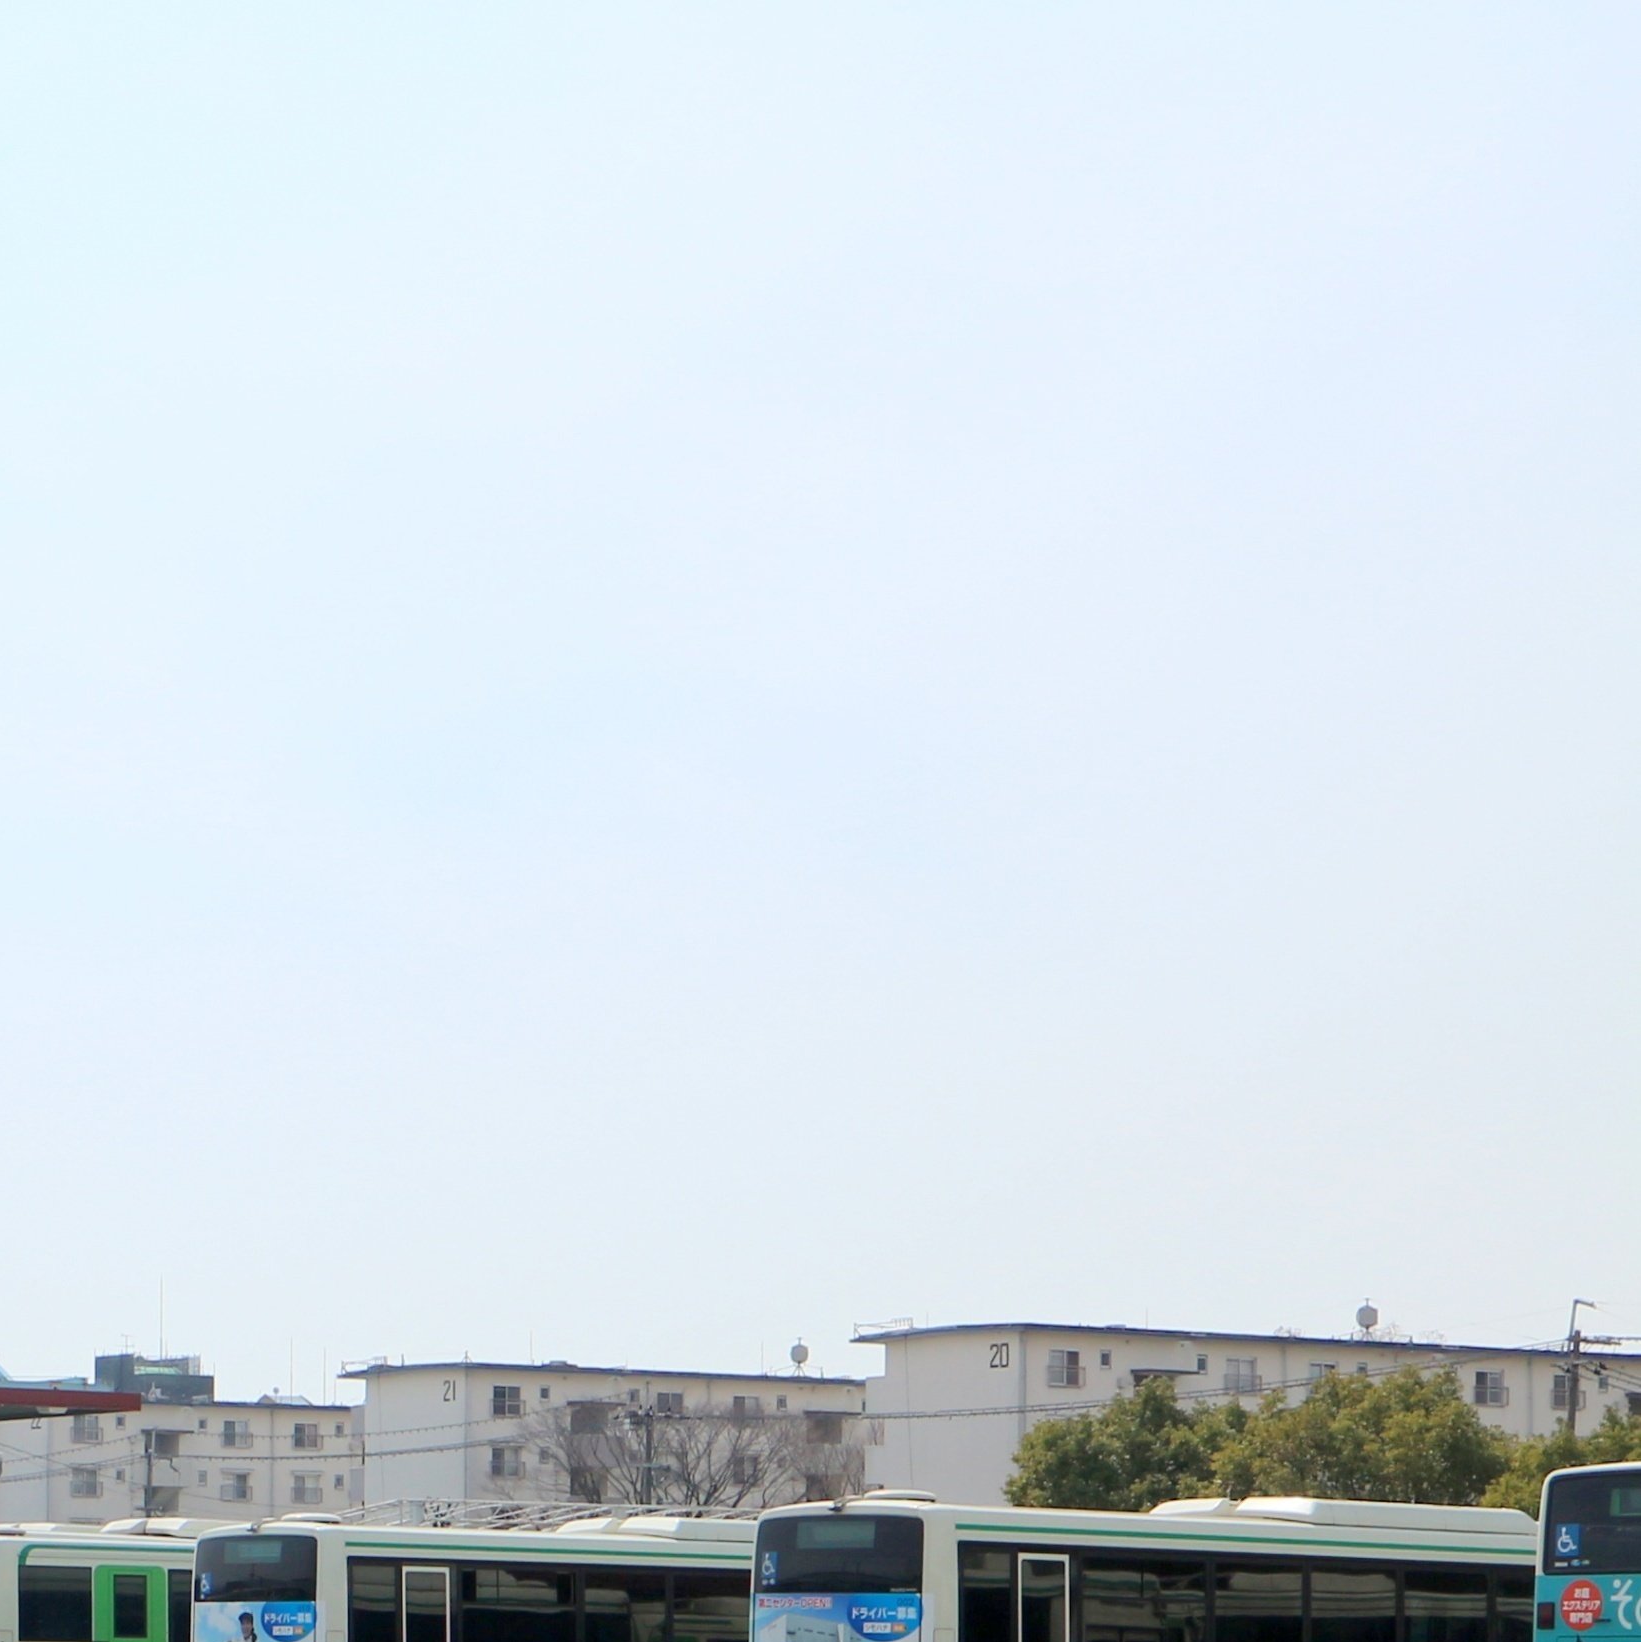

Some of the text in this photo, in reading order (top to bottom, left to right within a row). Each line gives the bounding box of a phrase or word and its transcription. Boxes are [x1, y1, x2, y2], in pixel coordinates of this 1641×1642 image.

[990, 1343, 1009, 1368] 20
[443, 1380, 456, 1402] 21
[1562, 1600, 1601, 1611] エクステリア
[1610, 1579, 1641, 1631] そ
